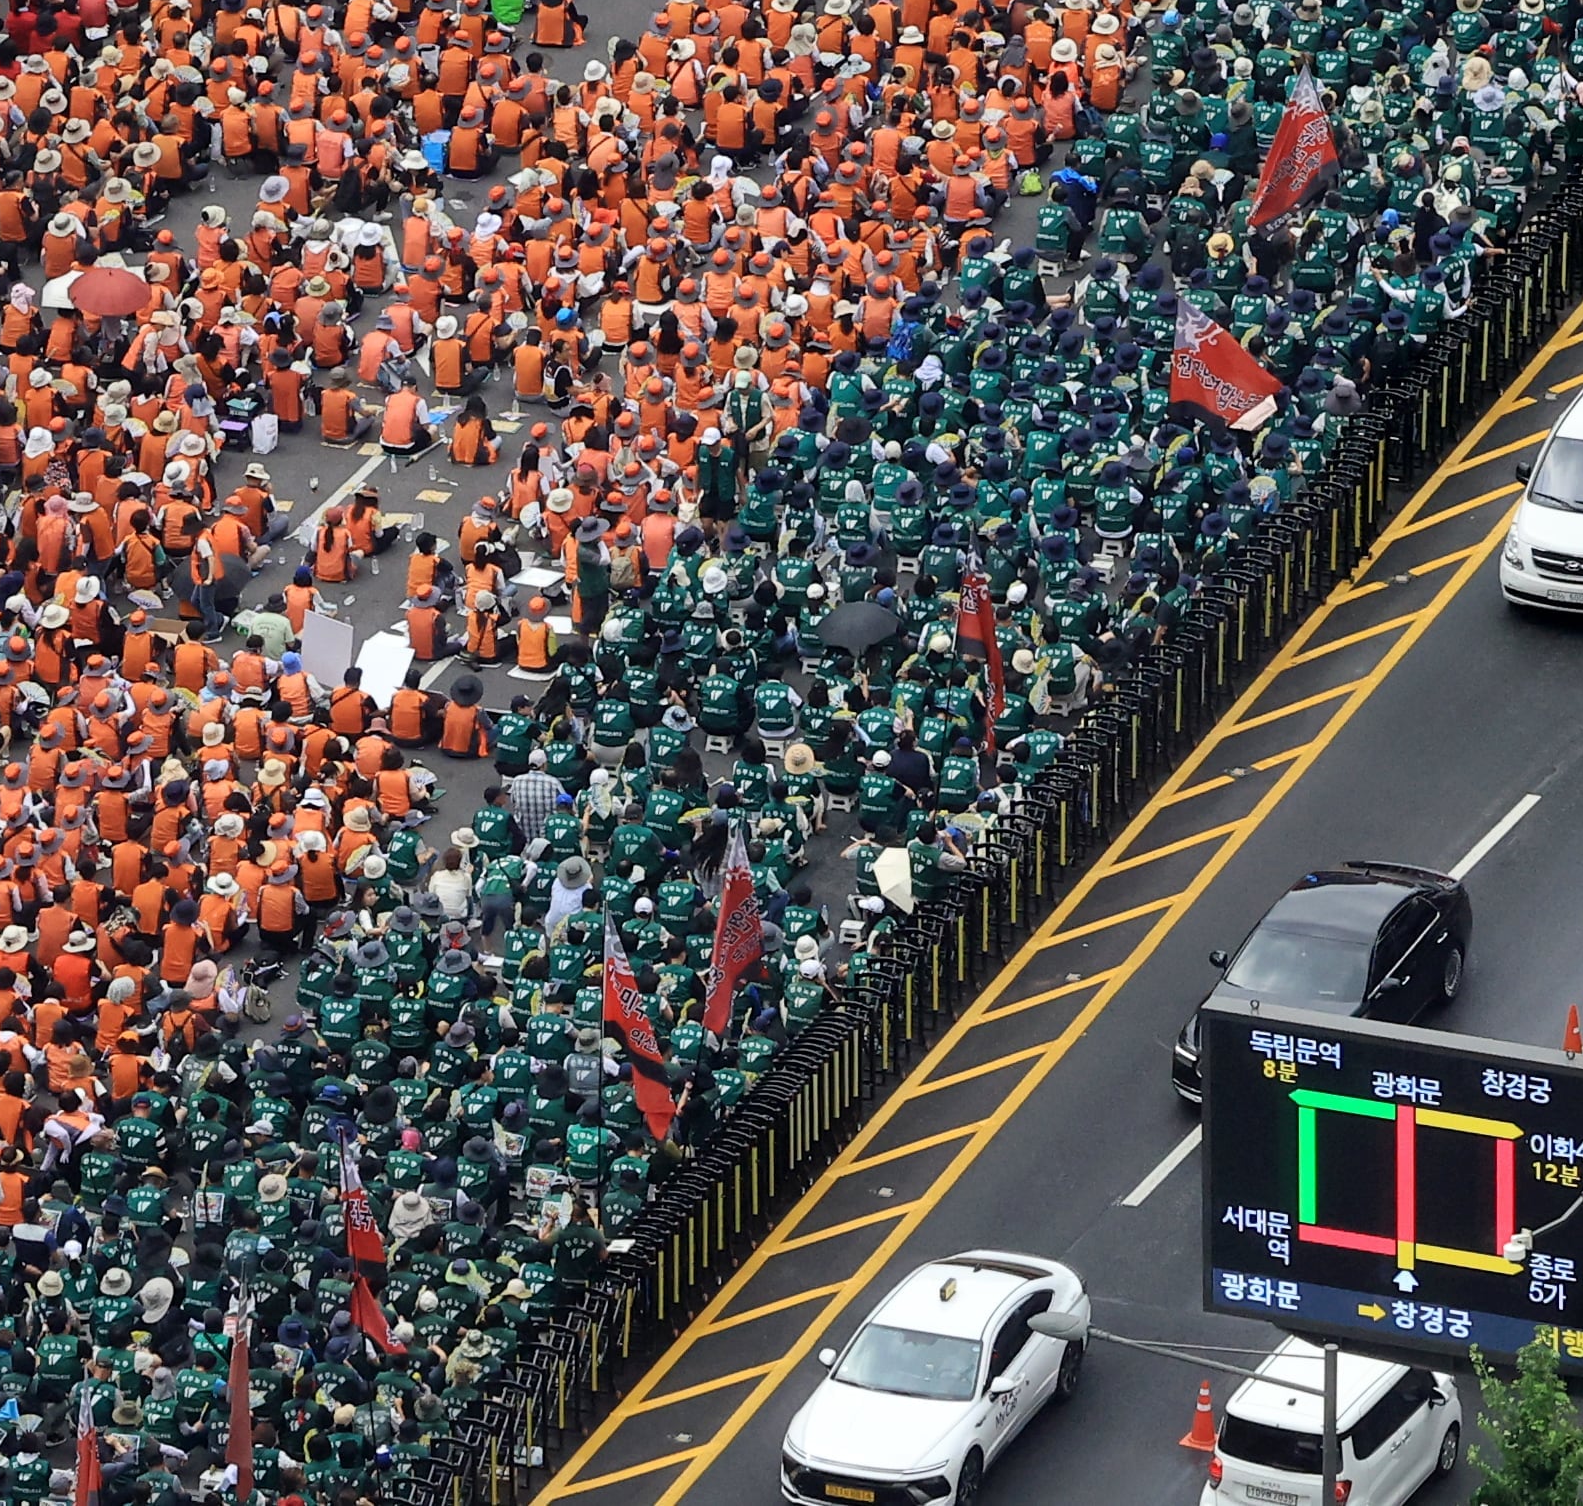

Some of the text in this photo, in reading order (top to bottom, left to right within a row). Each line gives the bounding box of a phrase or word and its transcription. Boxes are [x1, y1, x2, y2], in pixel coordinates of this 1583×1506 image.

[1249, 1030, 1341, 1069] 독립문역
[1262, 1059, 1299, 1084] 8분
[1372, 1070, 1443, 1106] 광화문
[1481, 1068, 1553, 1104] 창경궁
[1531, 1160, 1581, 1190] 12분
[1222, 1205, 1292, 1240] 서대문
[1267, 1238, 1291, 1266] 역
[1528, 1253, 1577, 1283] 종로
[1220, 1273, 1301, 1311] 광화문
[1528, 1282, 1567, 1311] 5가
[1390, 1300, 1472, 1338] 창경궁
